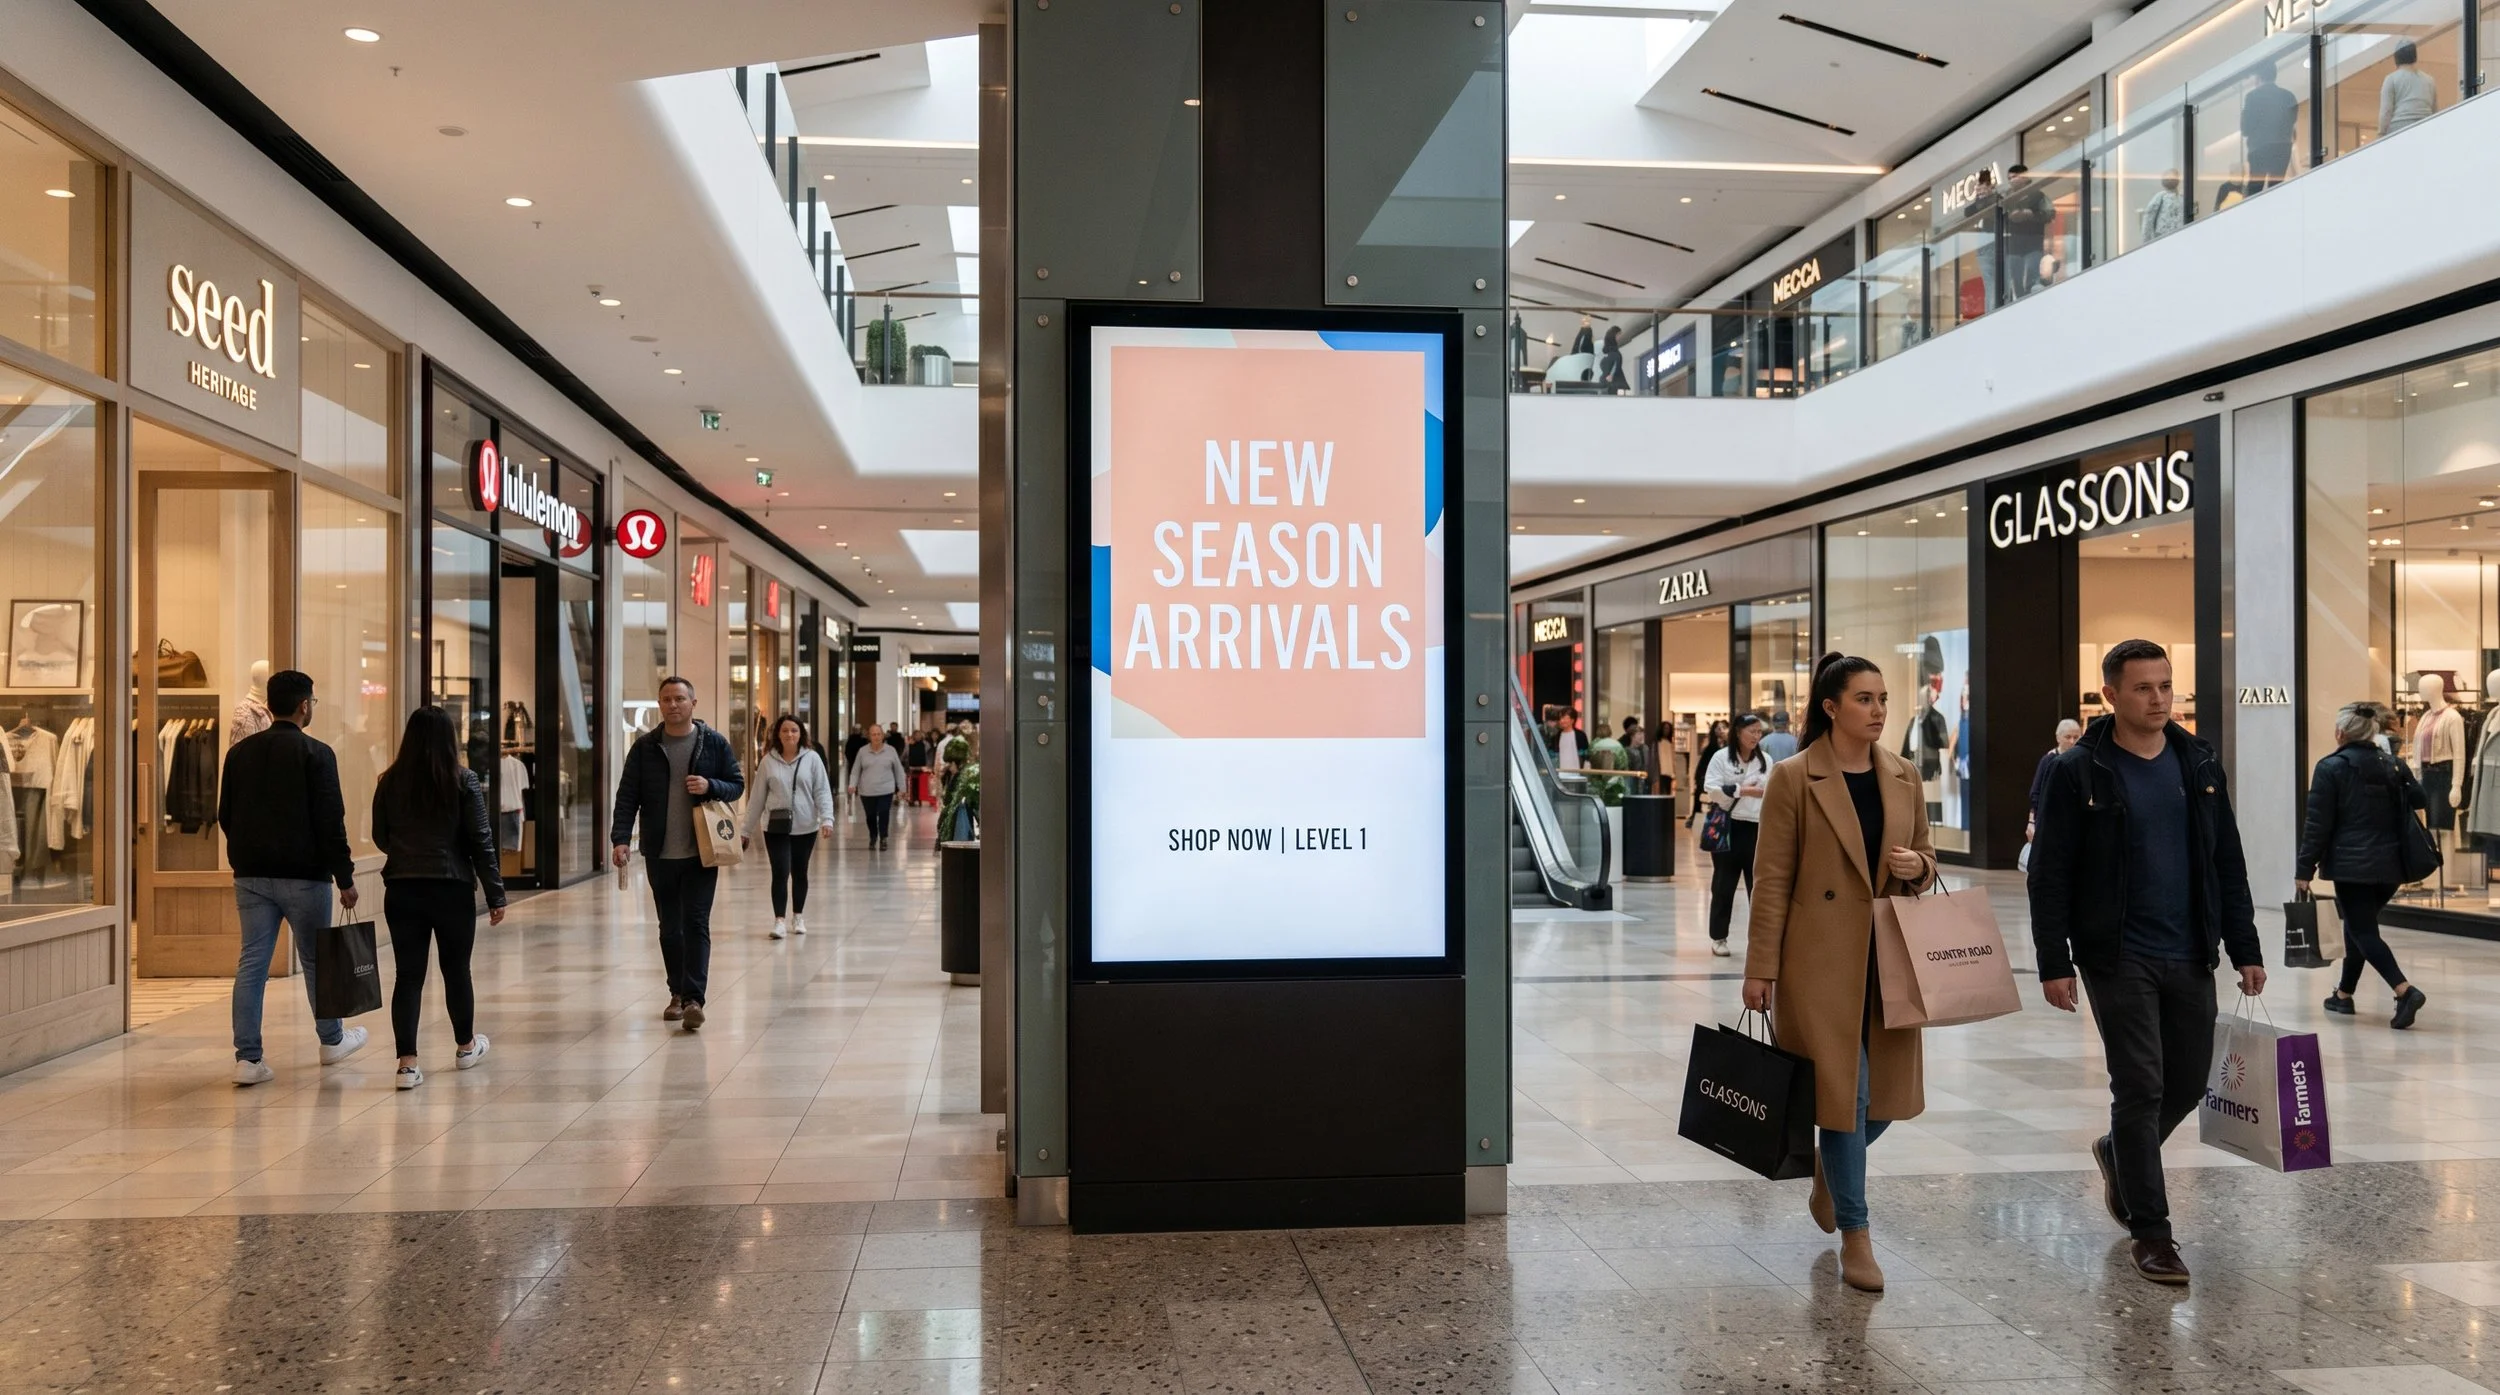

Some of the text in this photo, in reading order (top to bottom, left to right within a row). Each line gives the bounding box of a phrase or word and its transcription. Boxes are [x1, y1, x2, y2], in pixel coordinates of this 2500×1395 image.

[2263, 0, 2329, 37] ME
[1942, 161, 2003, 215] MECA
[1773, 258, 1821, 304] MECCA
[168, 264, 276, 379] seed
[189, 361, 257, 410] HERITAGE
[1204, 440, 1334, 506] NEW
[502, 456, 579, 541] lululemon
[1989, 450, 2191, 549] GLASSONS
[1152, 521, 1383, 589] SEASON
[1658, 568, 1710, 605] ZARA
[1124, 604, 1412, 671] ARRIVALS
[1534, 616, 1568, 643] MECCA
[2238, 686, 2291, 706] ZARA
[1168, 828, 1221, 851] SHOP
[1227, 828, 1273, 851] NOW
[1295, 827, 1353, 850] LEVEL
[1359, 827, 1367, 850] 1
[1926, 944, 1993, 962] COUNTRY ROAD
[1699, 1078, 1768, 1121] GLASSONS
[2205, 1087, 2259, 1125] Farmers
[2291, 1060, 2312, 1127] Farmers
